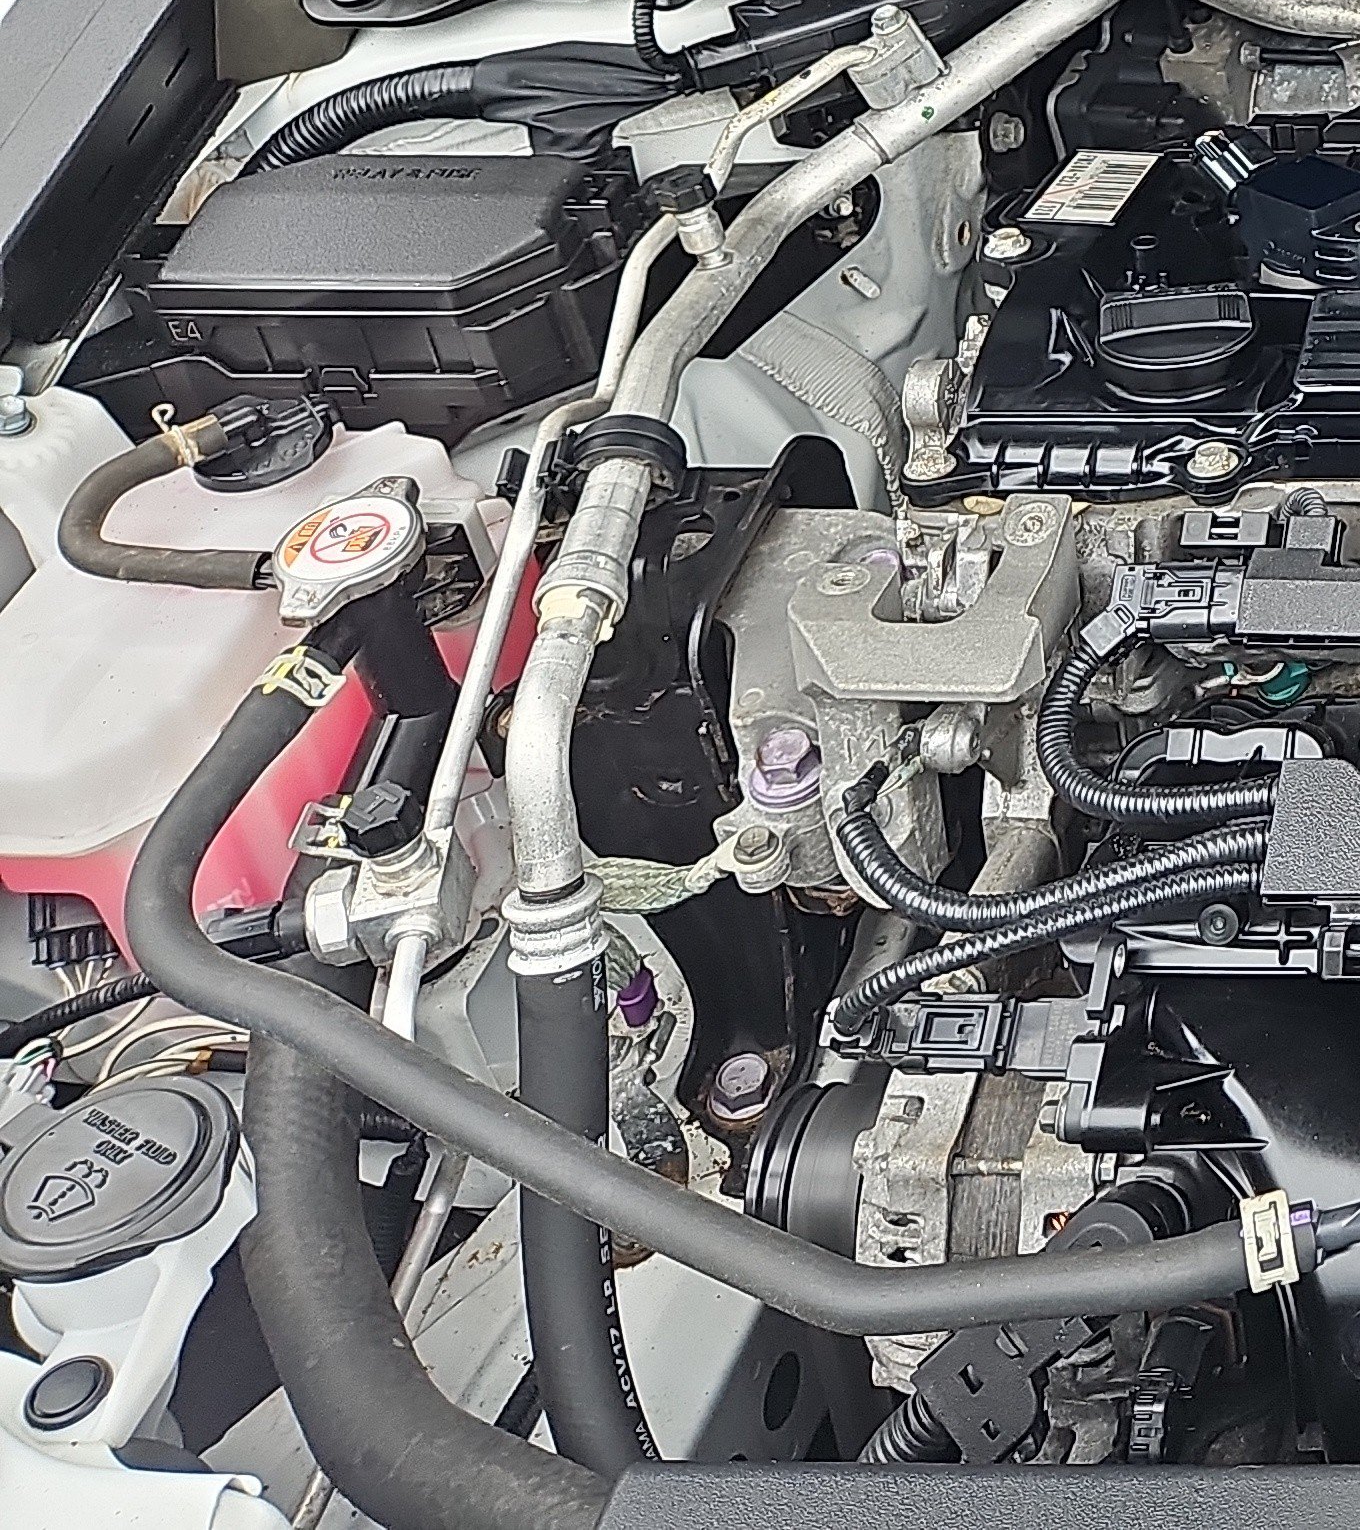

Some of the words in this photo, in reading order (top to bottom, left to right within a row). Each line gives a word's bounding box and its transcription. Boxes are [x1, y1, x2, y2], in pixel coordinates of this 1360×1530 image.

[167, 321, 202, 342] E4
[82, 1108, 141, 1146] WASHER
[134, 1138, 178, 1166] FLUID
[608, 1327, 638, 1409] ACV17
